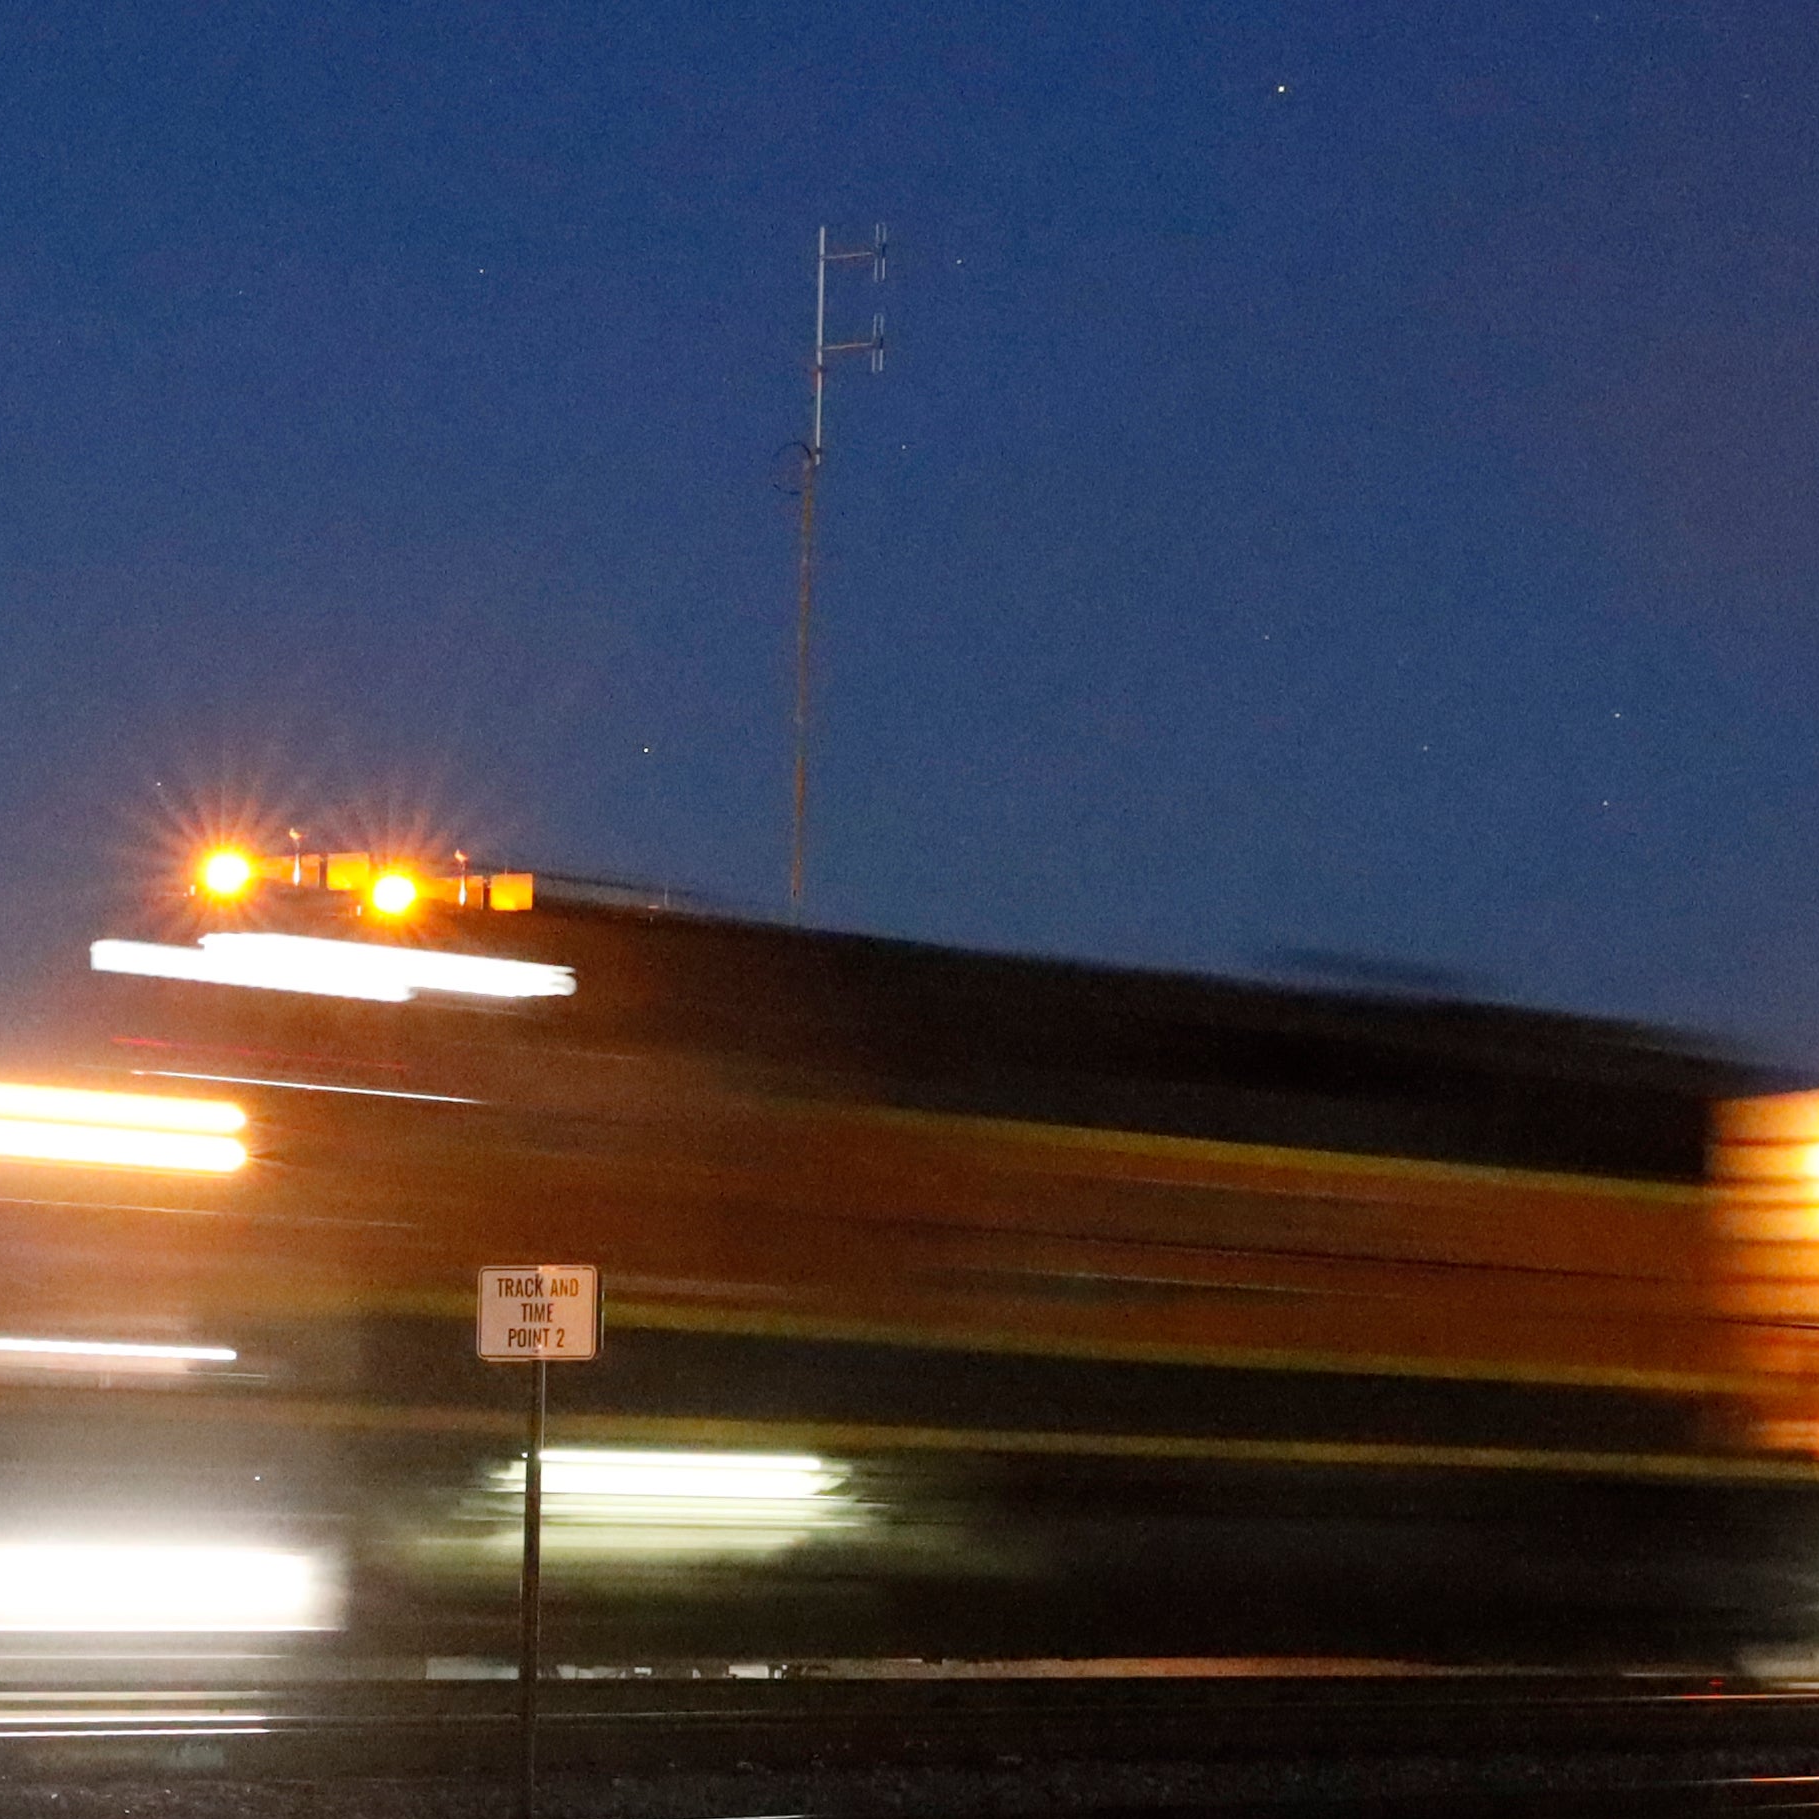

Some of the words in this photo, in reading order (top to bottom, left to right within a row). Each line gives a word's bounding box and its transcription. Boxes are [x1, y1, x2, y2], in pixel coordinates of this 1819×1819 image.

[497, 1277, 544, 1298] TRACK
[549, 1277, 579, 1298] AND
[520, 1303, 555, 1323] TIME
[507, 1328, 551, 1349] POINT
[556, 1328, 565, 1349] 2
